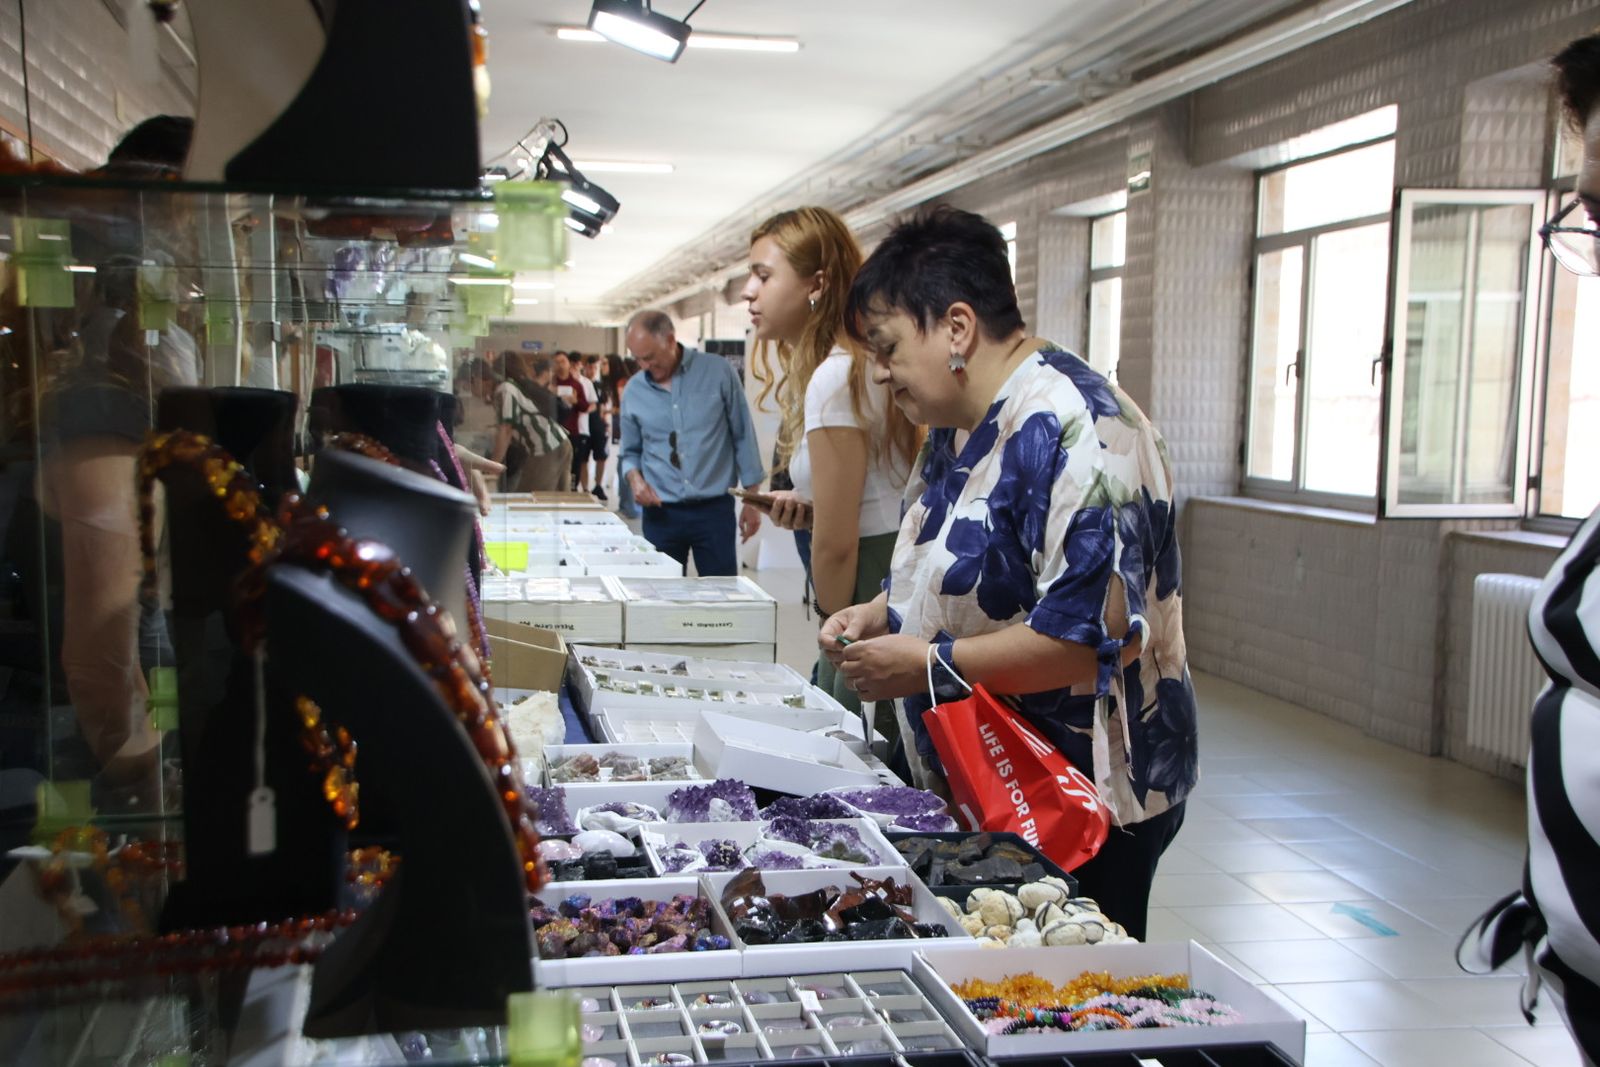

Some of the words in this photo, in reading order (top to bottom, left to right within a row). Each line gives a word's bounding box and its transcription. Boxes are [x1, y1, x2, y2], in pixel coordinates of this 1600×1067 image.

[979, 723, 1005, 757] LIFE
[996, 758, 1013, 778] IS
[1005, 779, 1029, 818] FOR
